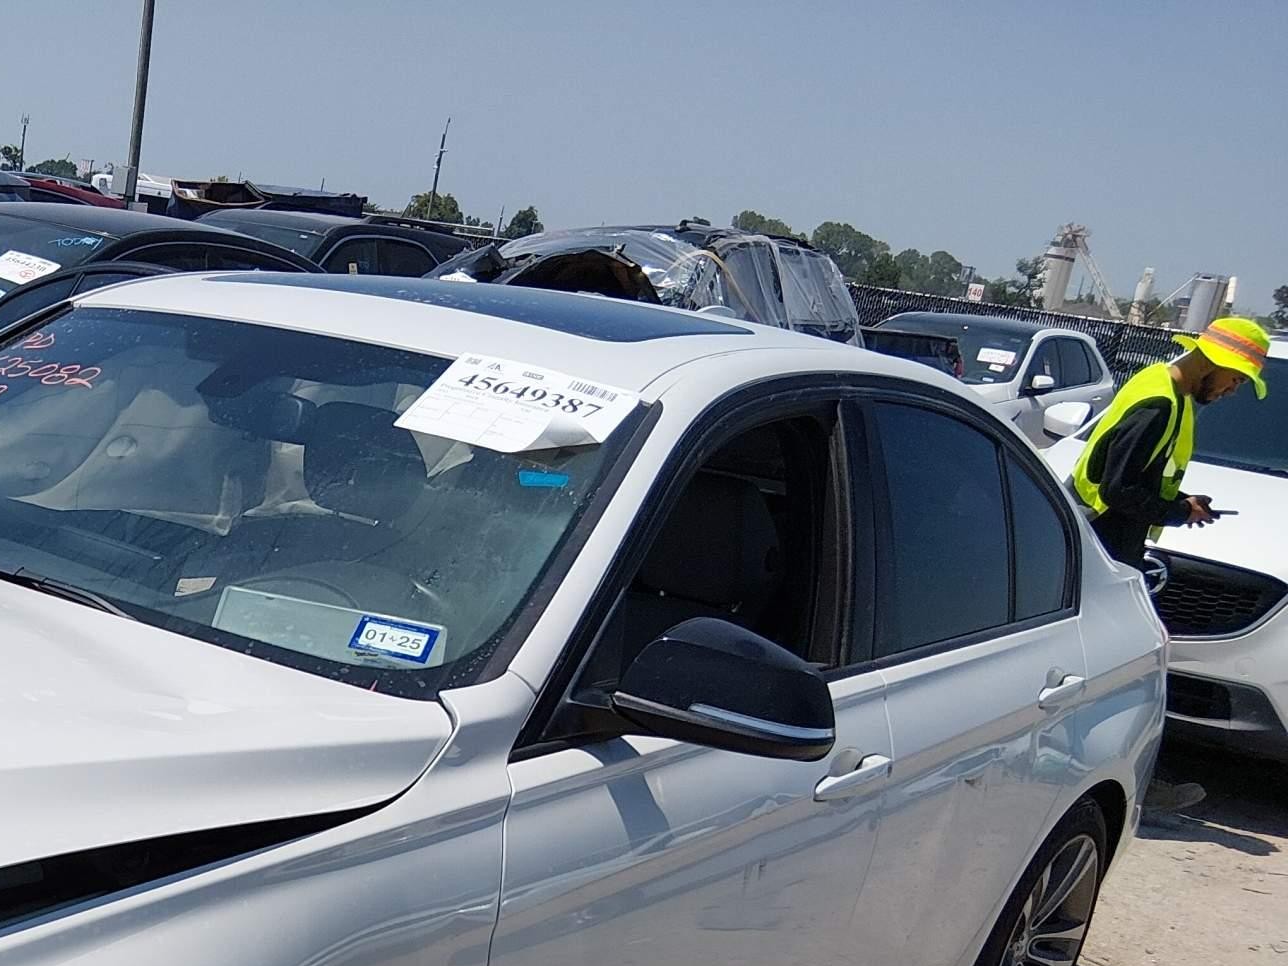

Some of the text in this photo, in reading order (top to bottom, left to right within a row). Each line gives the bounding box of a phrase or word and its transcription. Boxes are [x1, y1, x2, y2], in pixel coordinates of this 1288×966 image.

[458, 374, 605, 418] 45649387
[364, 629, 423, 650] 01 25
